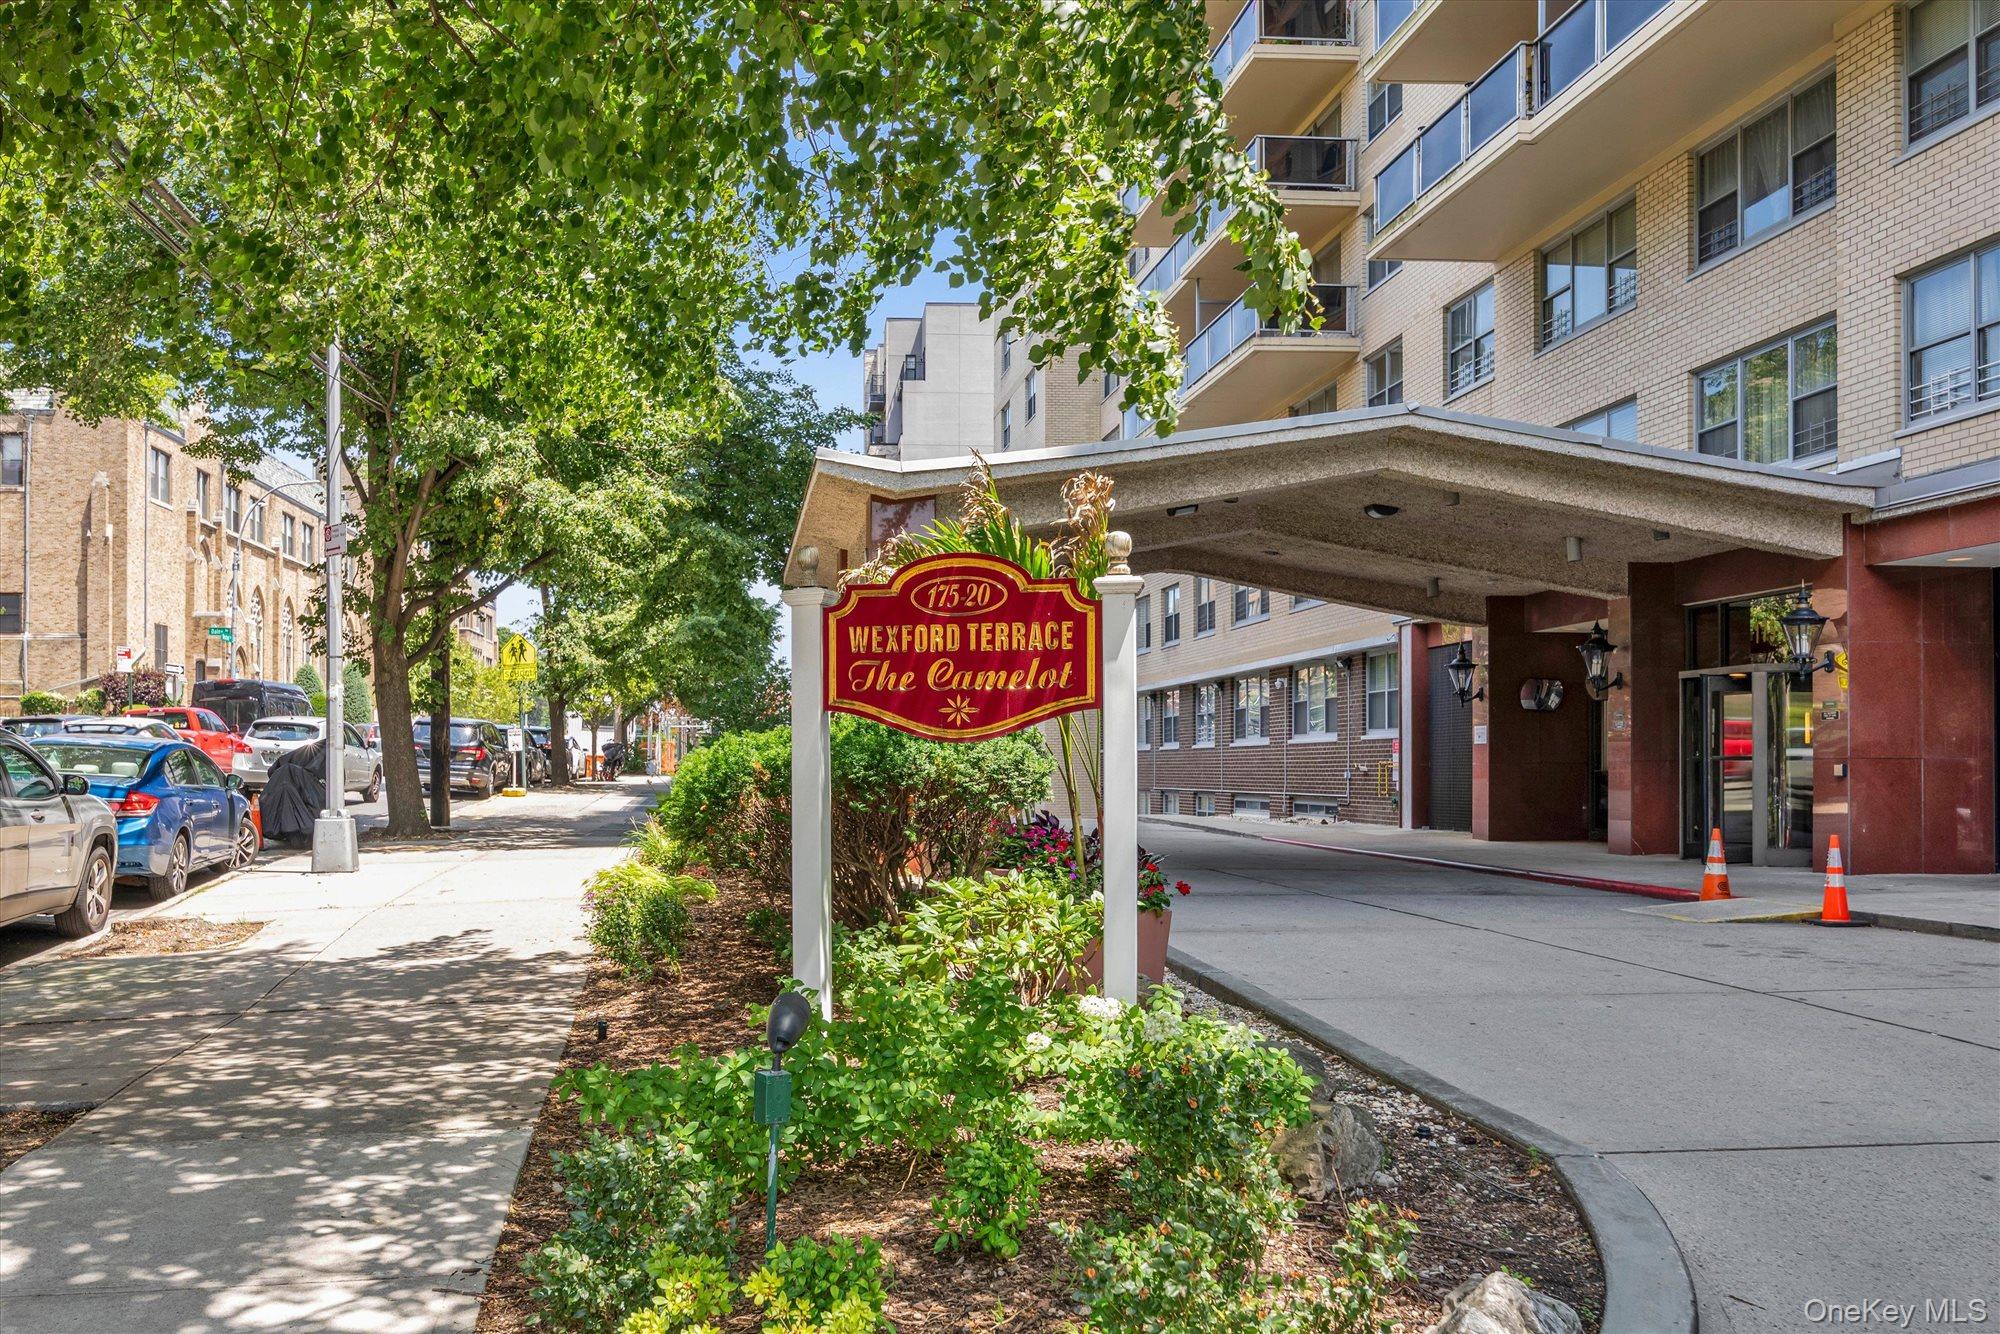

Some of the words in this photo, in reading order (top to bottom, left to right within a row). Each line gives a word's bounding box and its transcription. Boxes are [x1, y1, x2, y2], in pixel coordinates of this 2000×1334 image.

[927, 582, 991, 608] 175-20
[848, 623, 960, 653] WEXFORD
[966, 620, 1074, 652] TERRACE
[848, 659, 916, 692] The
[926, 656, 1075, 691] Camelot
